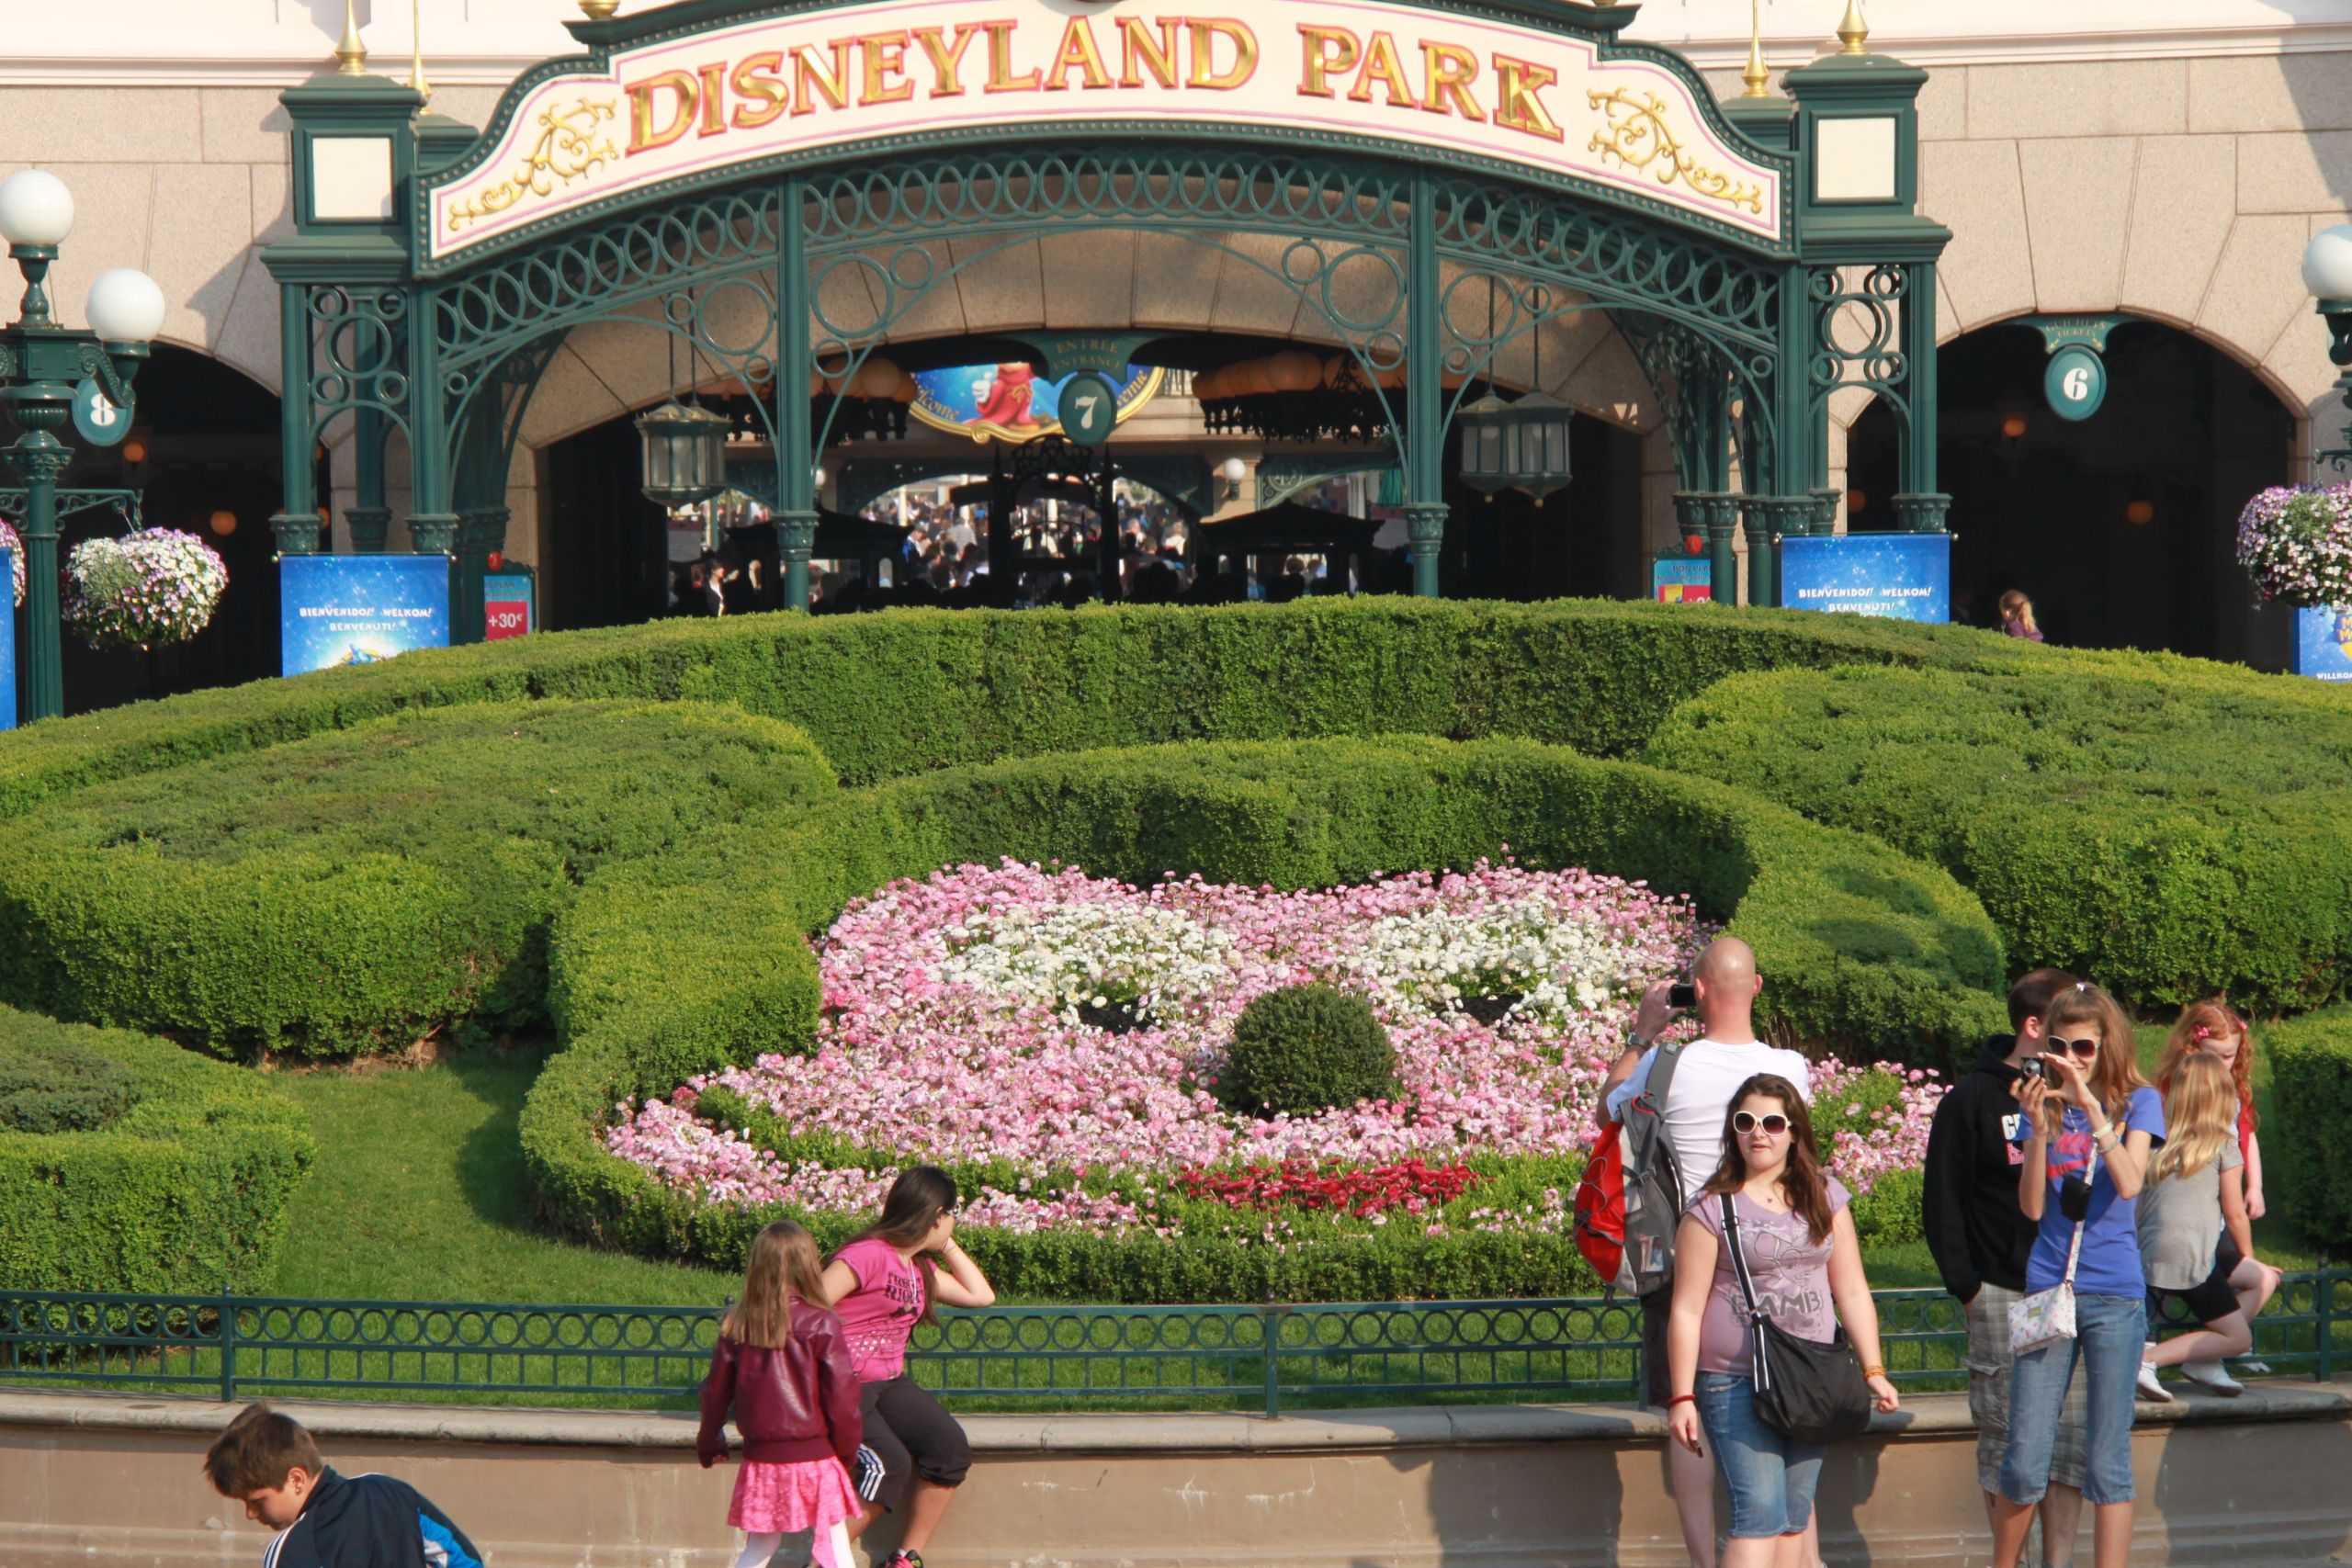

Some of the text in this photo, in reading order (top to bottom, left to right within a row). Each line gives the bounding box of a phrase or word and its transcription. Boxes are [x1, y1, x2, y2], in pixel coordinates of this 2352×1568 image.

[624, 15, 1565, 158] DISNEYLAND PARK
[2064, 367, 2088, 400] 6
[90, 393, 116, 426] 8
[1075, 396, 1098, 429] 7
[1798, 587, 1933, 598] BIENVENIDOS! WELKOM!
[300, 607, 433, 618] BIENVENIDOS! WELKOM!
[1730, 1290, 1824, 1317] BAMB
